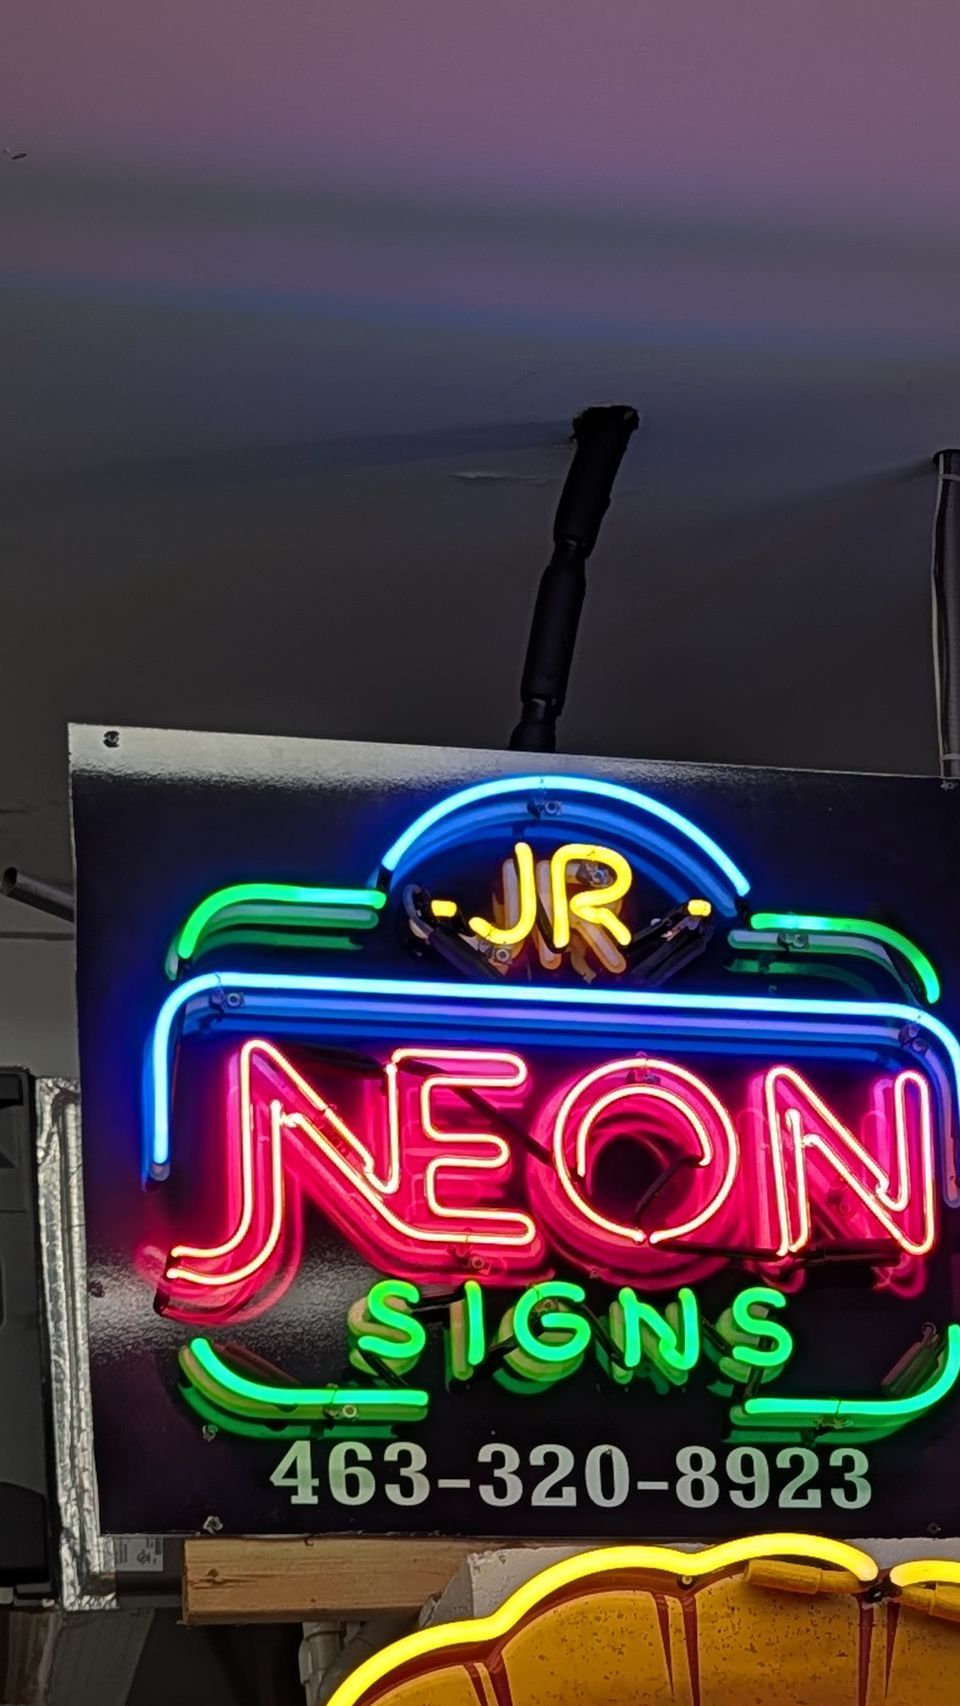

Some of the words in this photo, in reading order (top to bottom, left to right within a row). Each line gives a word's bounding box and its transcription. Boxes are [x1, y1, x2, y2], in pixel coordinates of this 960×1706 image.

[469, 841, 633, 951] JR
[164, 1038, 936, 1287] NEON
[351, 1278, 793, 1370] SIGNS
[269, 1440, 873, 1510] 463-320-8923
